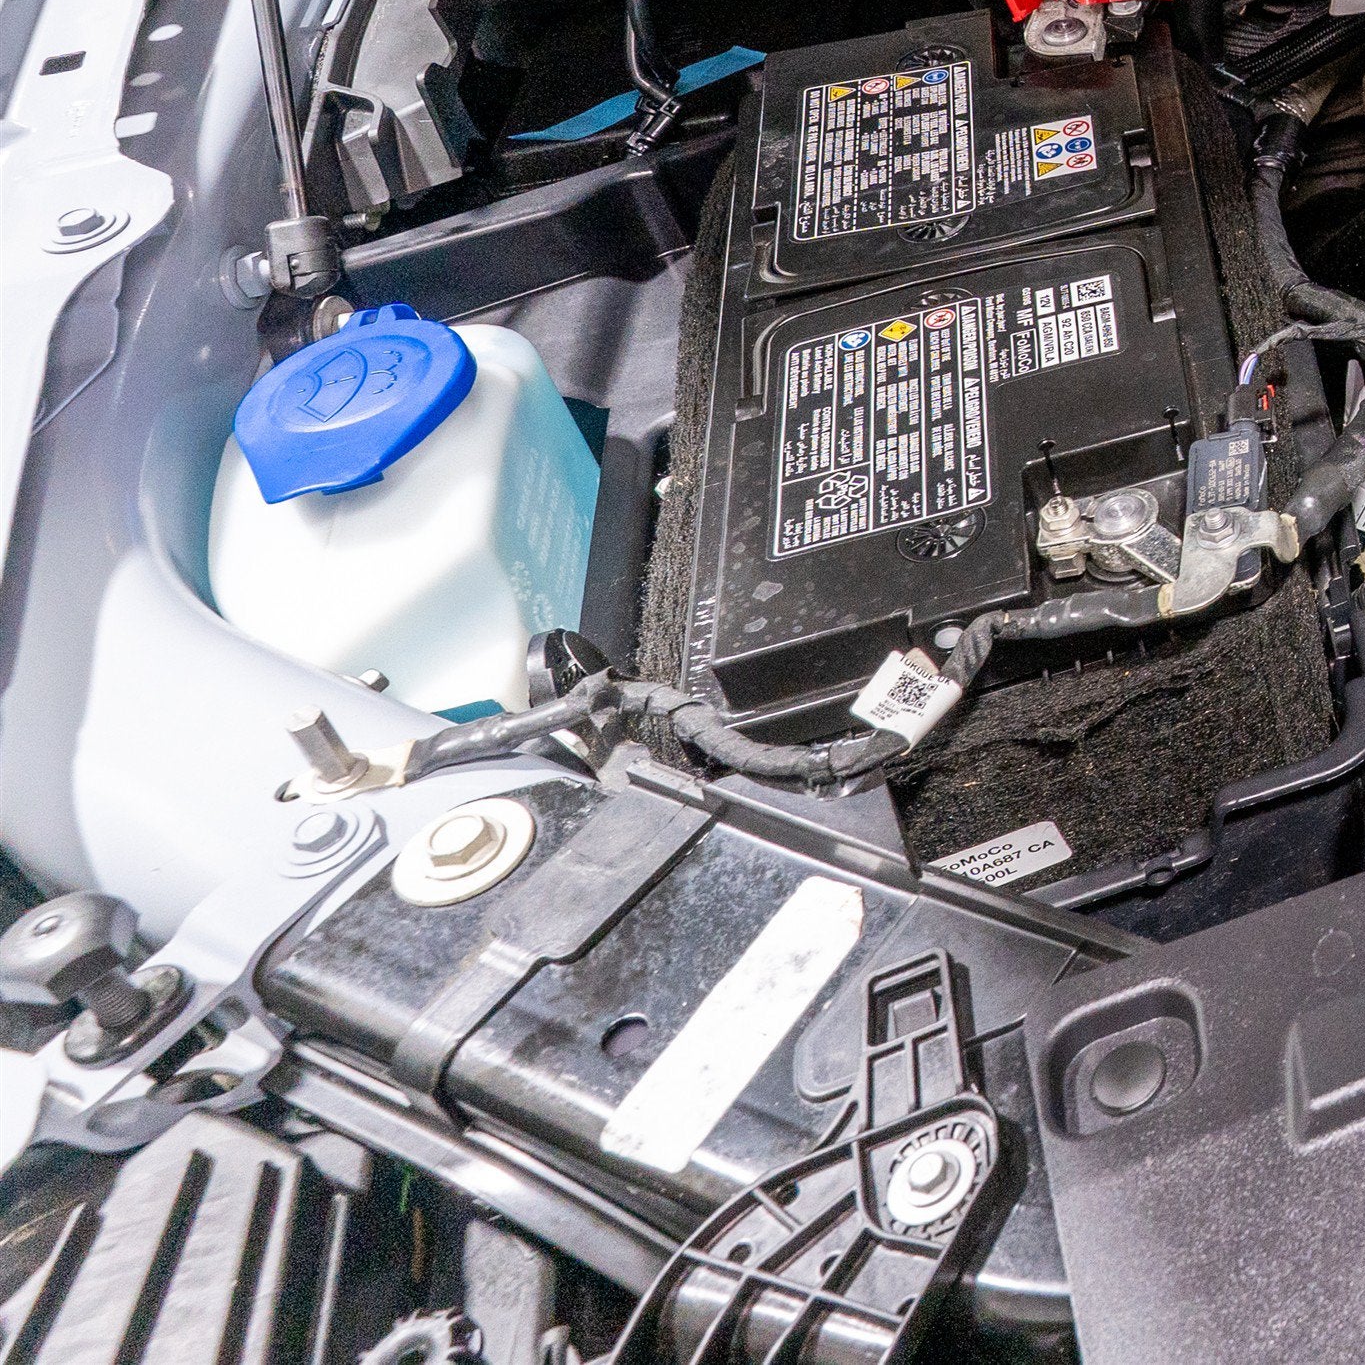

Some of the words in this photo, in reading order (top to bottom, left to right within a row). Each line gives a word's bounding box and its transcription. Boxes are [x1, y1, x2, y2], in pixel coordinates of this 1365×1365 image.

[1040, 294, 1050, 307] 12V
[1016, 308, 1033, 325] MF
[1061, 318, 1071, 328] 92
[1063, 330, 1072, 340] Ah
[1082, 322, 1092, 334] CCA
[962, 313, 977, 370] DANGER/POISON
[1042, 322, 1054, 362] AGM/VRLA
[1063, 340, 1074, 355] C20
[814, 345, 823, 359] Lead
[1016, 331, 1032, 372] FoMoCo
[814, 360, 822, 373] Acid
[823, 343, 832, 389] NON-SPILLABLE
[812, 373, 821, 393] Battery
[821, 406, 831, 431] CONTRA
[965, 386, 980, 447] PELIGRO/VENENO
[820, 432, 829, 467] DERRAMES
[836, 483, 848, 496] Pb
[1027, 839, 1055, 853] CA
